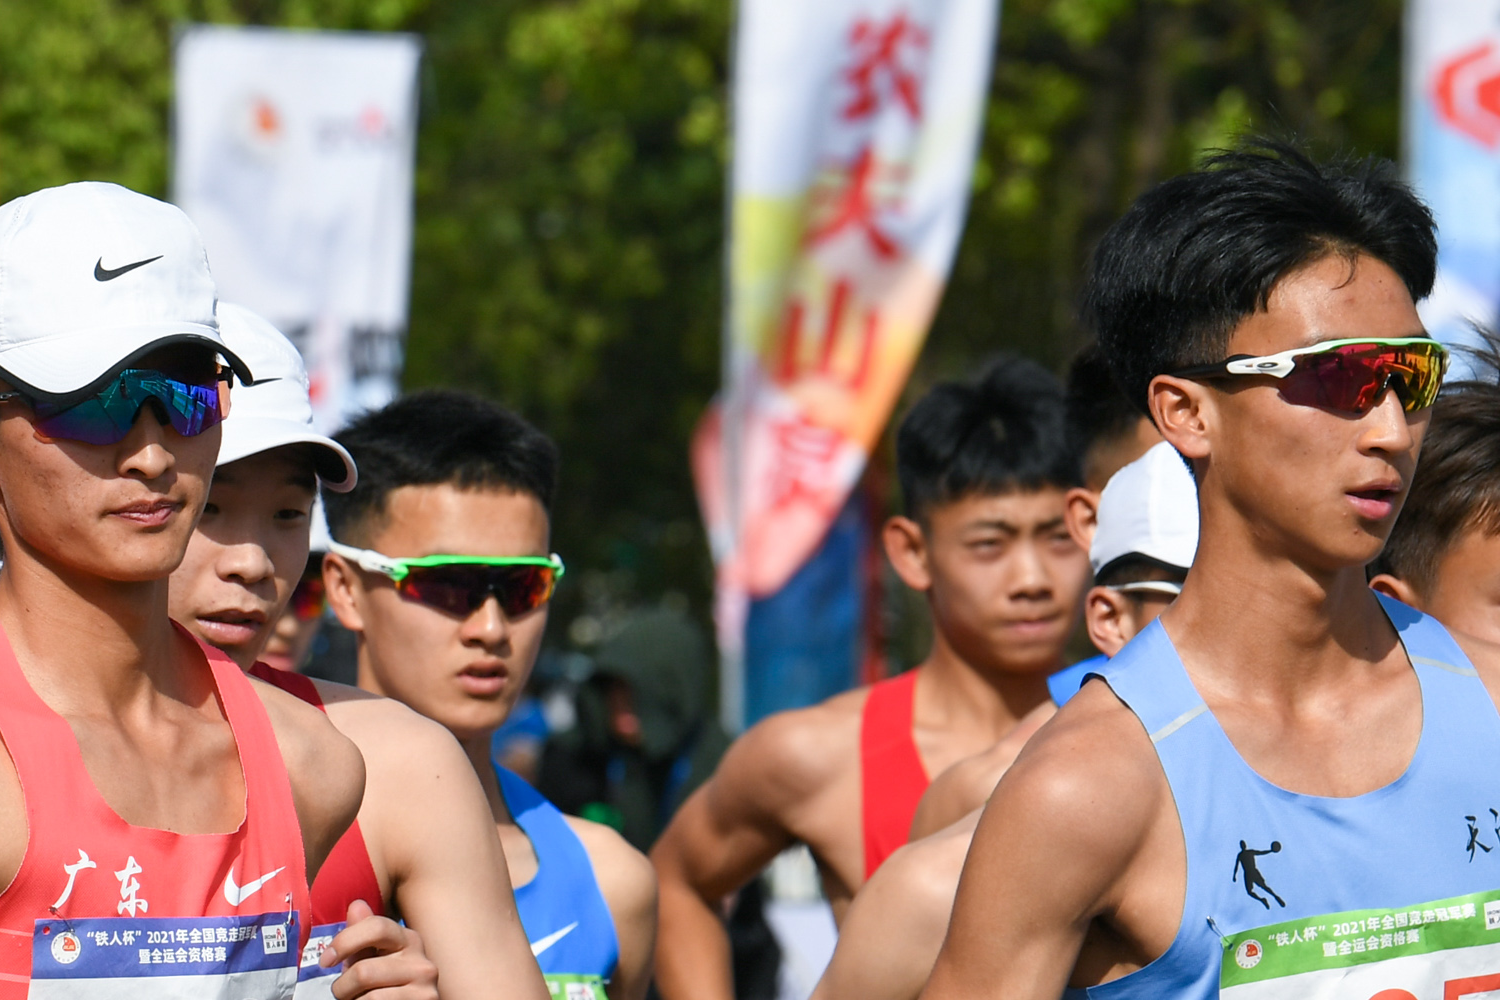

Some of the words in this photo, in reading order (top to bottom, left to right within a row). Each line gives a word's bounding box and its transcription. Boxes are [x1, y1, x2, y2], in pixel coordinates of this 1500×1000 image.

[51, 848, 149, 917] 广东
[86, 929, 142, 947] “铁人杯”
[1267, 925, 1326, 947] “铁人杯”
[1333, 902, 1476, 937] 2021年全国竞走冠军赛
[139, 947, 227, 964] 暨全运会资格赛
[1322, 929, 1420, 957] 暨全运会资格赛
